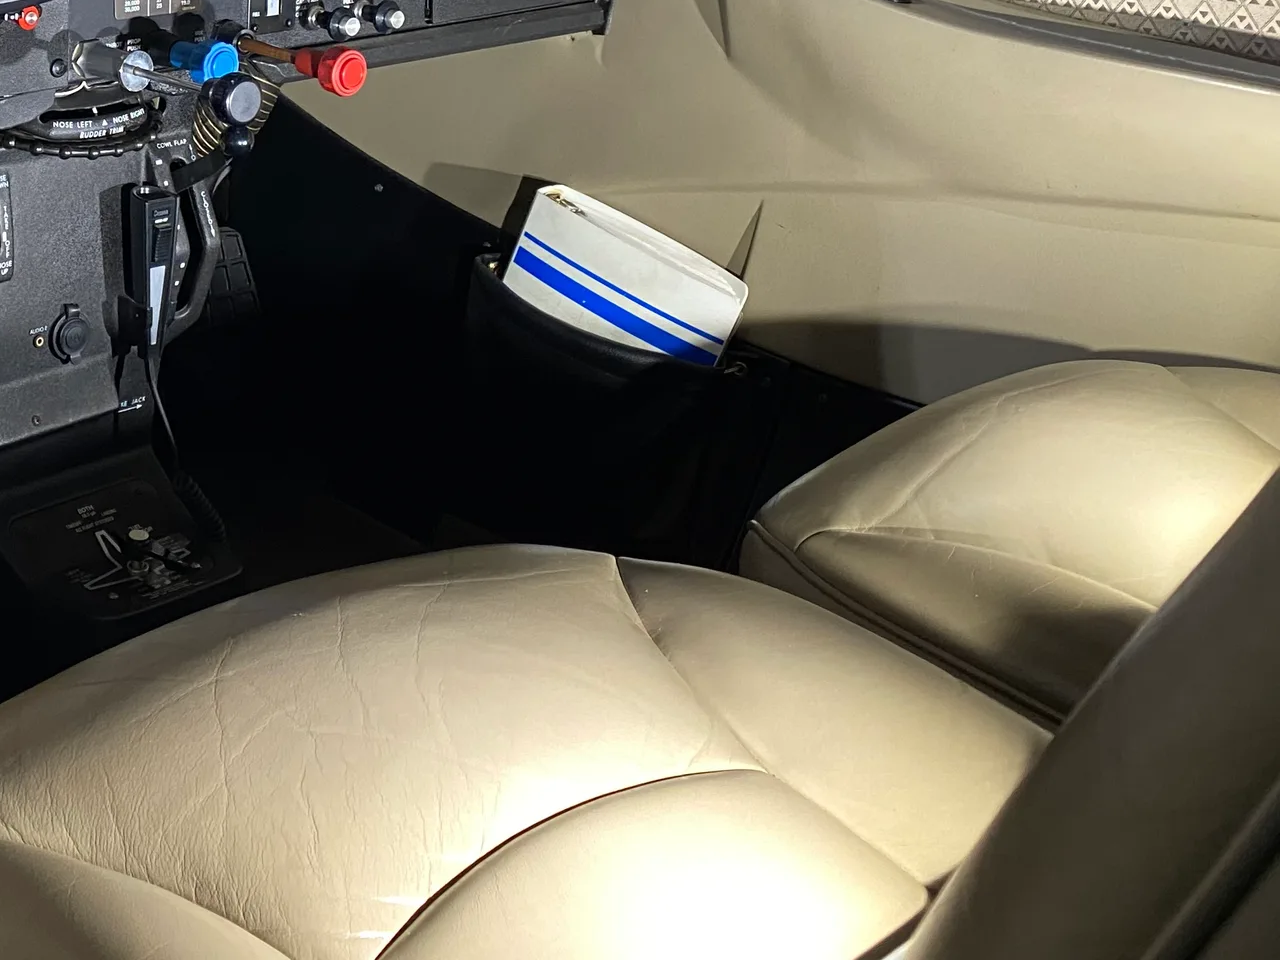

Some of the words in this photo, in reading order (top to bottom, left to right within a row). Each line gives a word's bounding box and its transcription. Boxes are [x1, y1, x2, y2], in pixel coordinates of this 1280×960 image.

[53, 120, 74, 129] NOSE
[77, 120, 93, 128] LEFT
[113, 114, 129, 124] NOSE
[129, 107, 146, 120] RIGHT
[79, 129, 107, 139] RUDDER
[109, 125, 125, 135] TRIM
[156, 141, 173, 150] COWL
[173, 138, 187, 146] FLAP
[29, 327, 43, 335] AUDIO
[131, 396, 145, 405] JACK
[76, 504, 95, 515] BOTH
